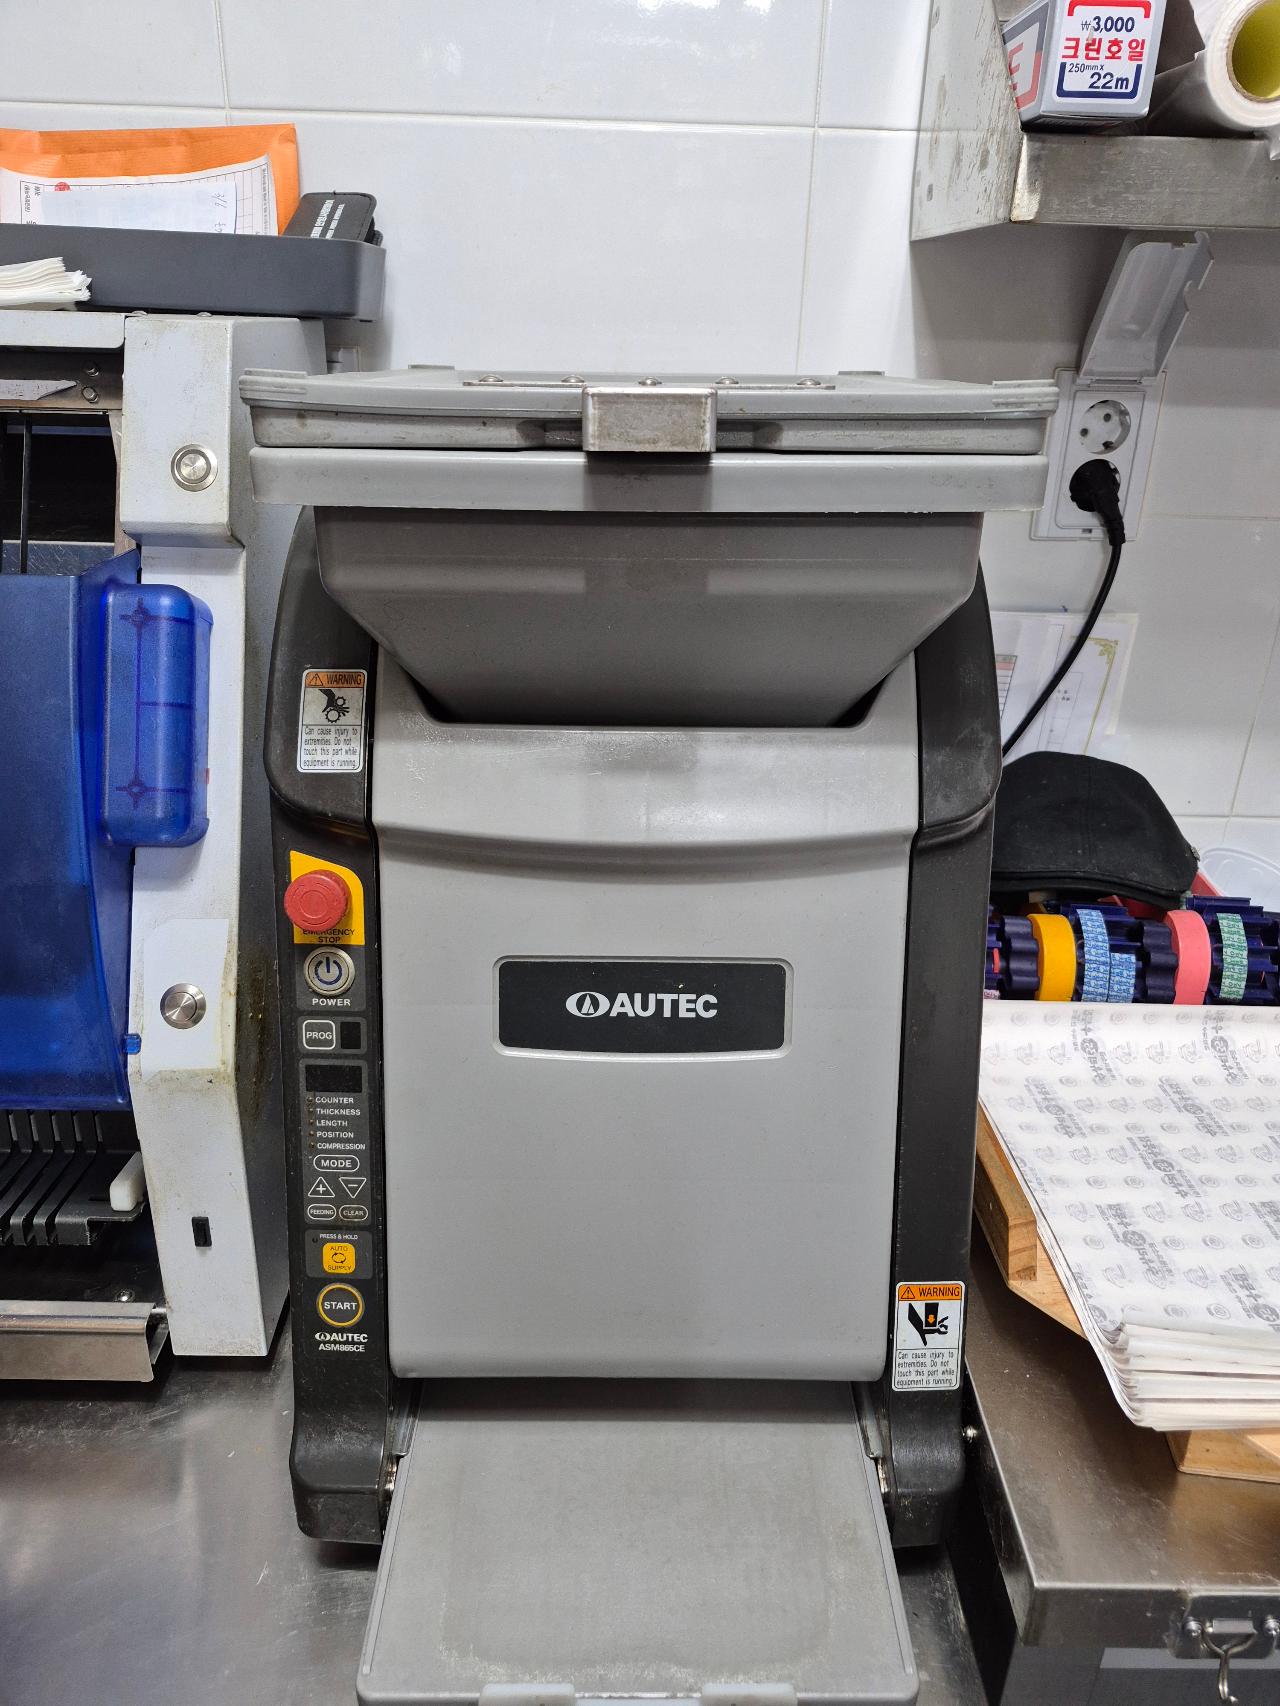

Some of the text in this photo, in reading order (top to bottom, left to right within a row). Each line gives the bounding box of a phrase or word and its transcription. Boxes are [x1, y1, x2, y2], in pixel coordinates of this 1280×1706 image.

[1061, 37, 1146, 61] 크린호일
[1088, 71, 1129, 90] 22m
[326, 673, 362, 686] WARNING
[304, 727, 358, 738] Can cause injury to
[334, 737, 341, 746] Do
[343, 738, 352, 746] not
[320, 747, 330, 756] this
[332, 748, 343, 758] part
[344, 747, 358, 756] while
[318, 936, 341, 944] STOP
[312, 998, 351, 1007] POWER
[609, 992, 718, 1019] AUTEC
[306, 1031, 333, 1040] PROG
[315, 1096, 354, 1104] COUNTER
[316, 1108, 361, 1116] THICKNESS
[316, 1119, 348, 1127] LENGTH
[316, 1131, 354, 1139] POSITION
[316, 1142, 366, 1150] COMPRESSION
[321, 1159, 352, 1168] MODE
[918, 1286, 960, 1297] WARNING
[324, 1301, 357, 1310] START
[330, 1332, 368, 1343] AUTEC
[318, 1343, 366, 1352] ASM865CE
[897, 1351, 908, 1360] Can
[929, 1351, 945, 1361] injury
[948, 1351, 954, 1359] to
[930, 1359, 938, 1368] Do
[940, 1360, 950, 1368] not
[897, 1368, 955, 1379] touch this part while
[896, 1378, 924, 1387] equipment
